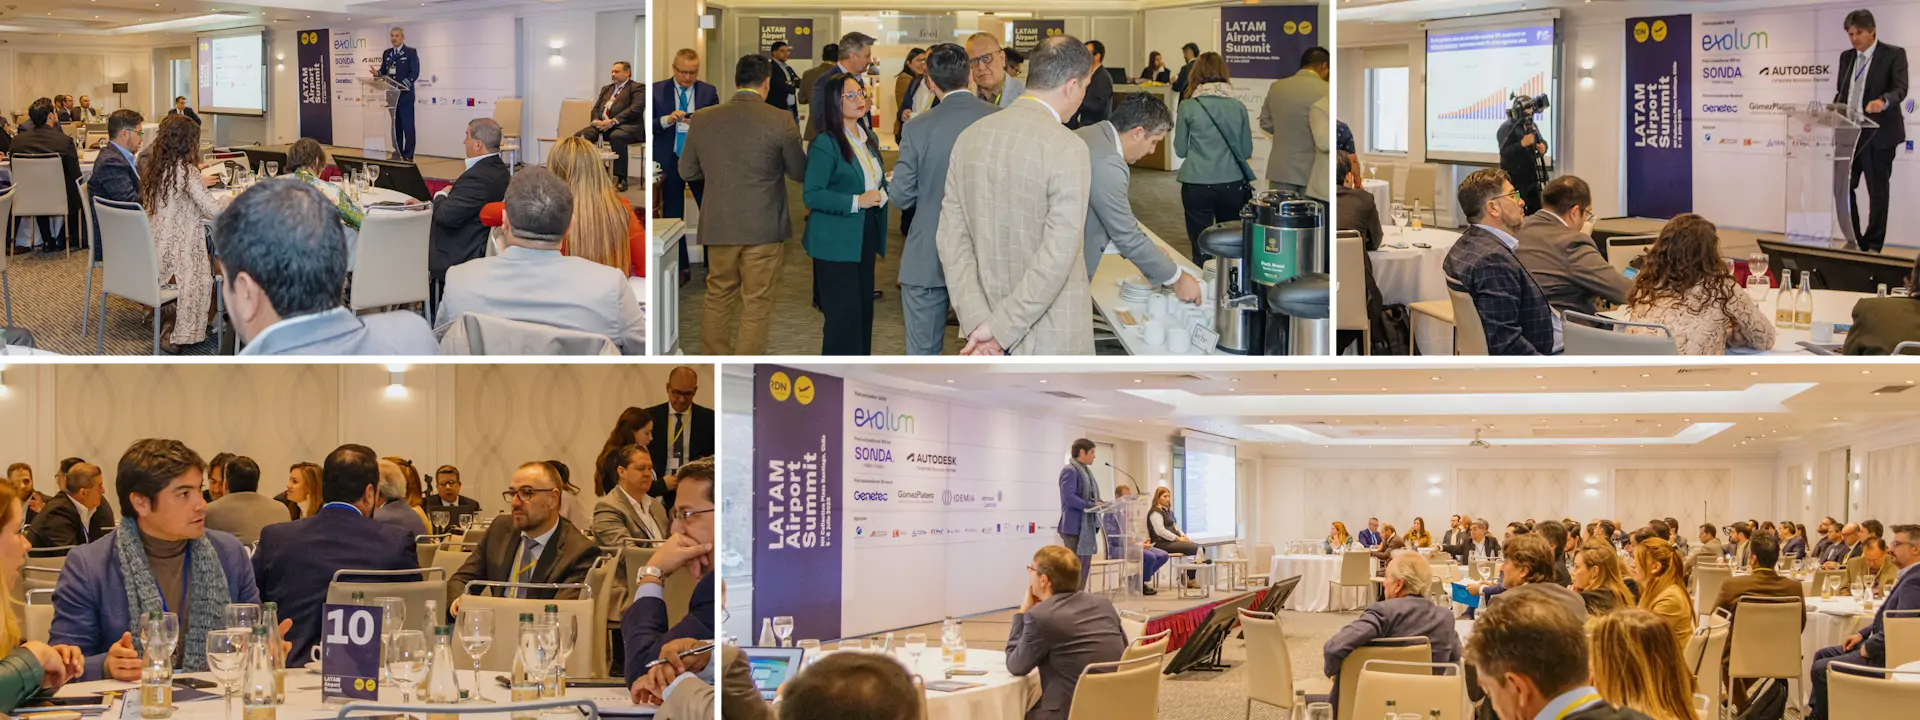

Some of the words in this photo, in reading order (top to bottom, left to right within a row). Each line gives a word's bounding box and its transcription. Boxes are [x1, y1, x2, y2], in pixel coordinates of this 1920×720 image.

[1226, 21, 1266, 31] LATAM
[334, 36, 366, 49] exolum
[1226, 32, 1266, 44] Airport
[1702, 28, 1768, 51] exolum
[1226, 42, 1271, 53] Summit
[1703, 66, 1742, 78] SONDA
[1772, 65, 1830, 75] AUTODESK
[1634, 84, 1645, 147] LATAM
[1647, 83, 1660, 148] Airport
[1659, 76, 1670, 148] Summit
[1702, 104, 1737, 113] Genetec
[854, 406, 914, 434] exolum
[855, 447, 893, 462] SONDA
[917, 454, 957, 466] AUTODESK
[803, 452, 817, 548] Summit
[854, 490, 888, 501] Genetec
[953, 494, 975, 502] IDEMIA
[768, 459, 785, 550] LATAM
[786, 461, 803, 549] Airport
[327, 609, 374, 645] 10
